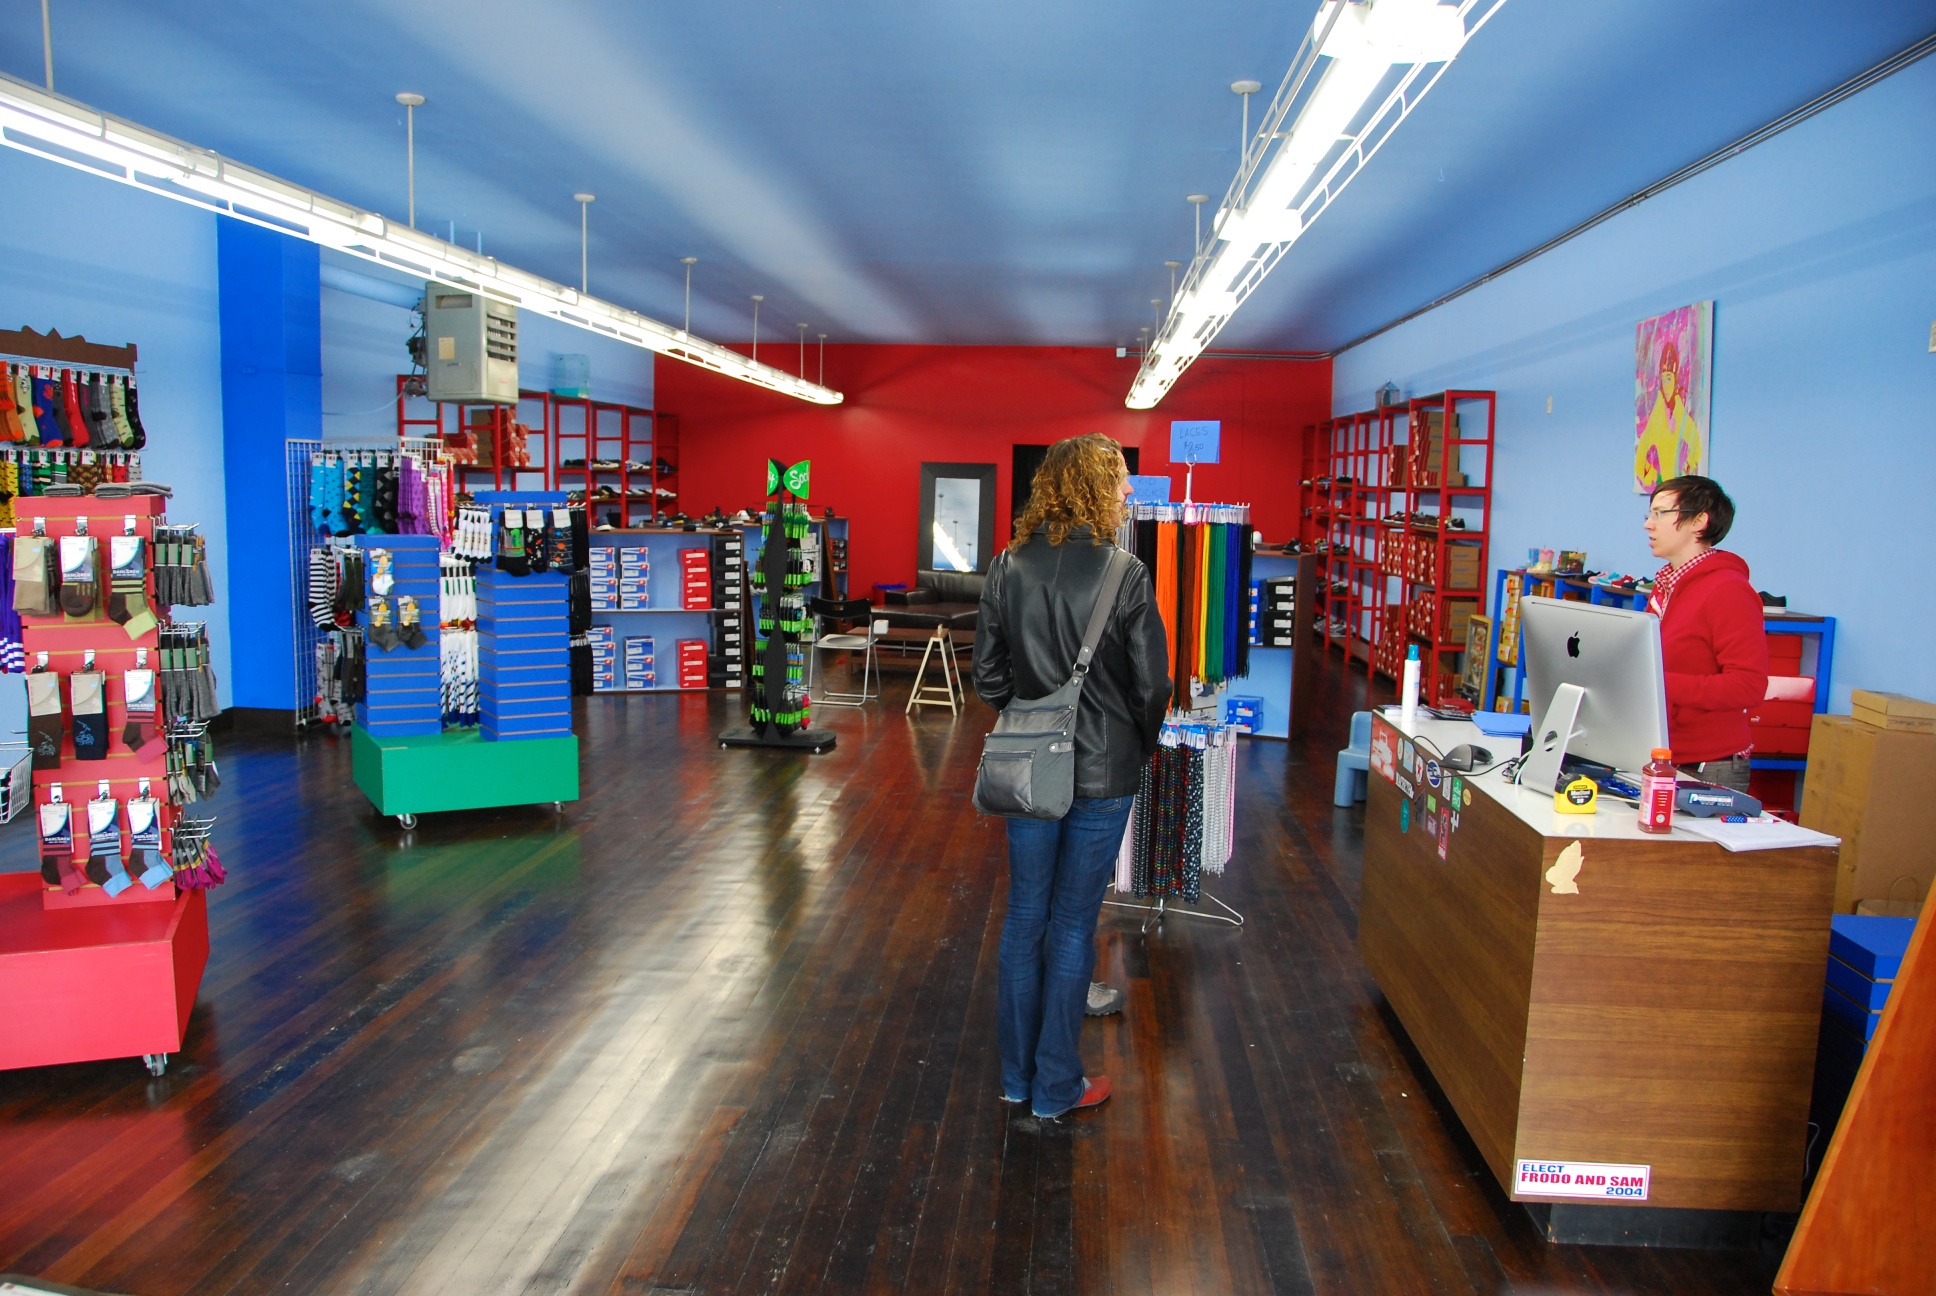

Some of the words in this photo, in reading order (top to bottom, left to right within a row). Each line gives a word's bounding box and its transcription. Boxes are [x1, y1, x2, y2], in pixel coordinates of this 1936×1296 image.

[1179, 426, 1208, 439] LACES
[1138, 478, 1157, 486] KID
[1522, 1164, 1565, 1173] ELECT
[1521, 1172, 1571, 1184] FRODO
[1574, 1175, 1606, 1186] AND
[1610, 1176, 1644, 1187] SAM
[1606, 1187, 1643, 1196] 2004
